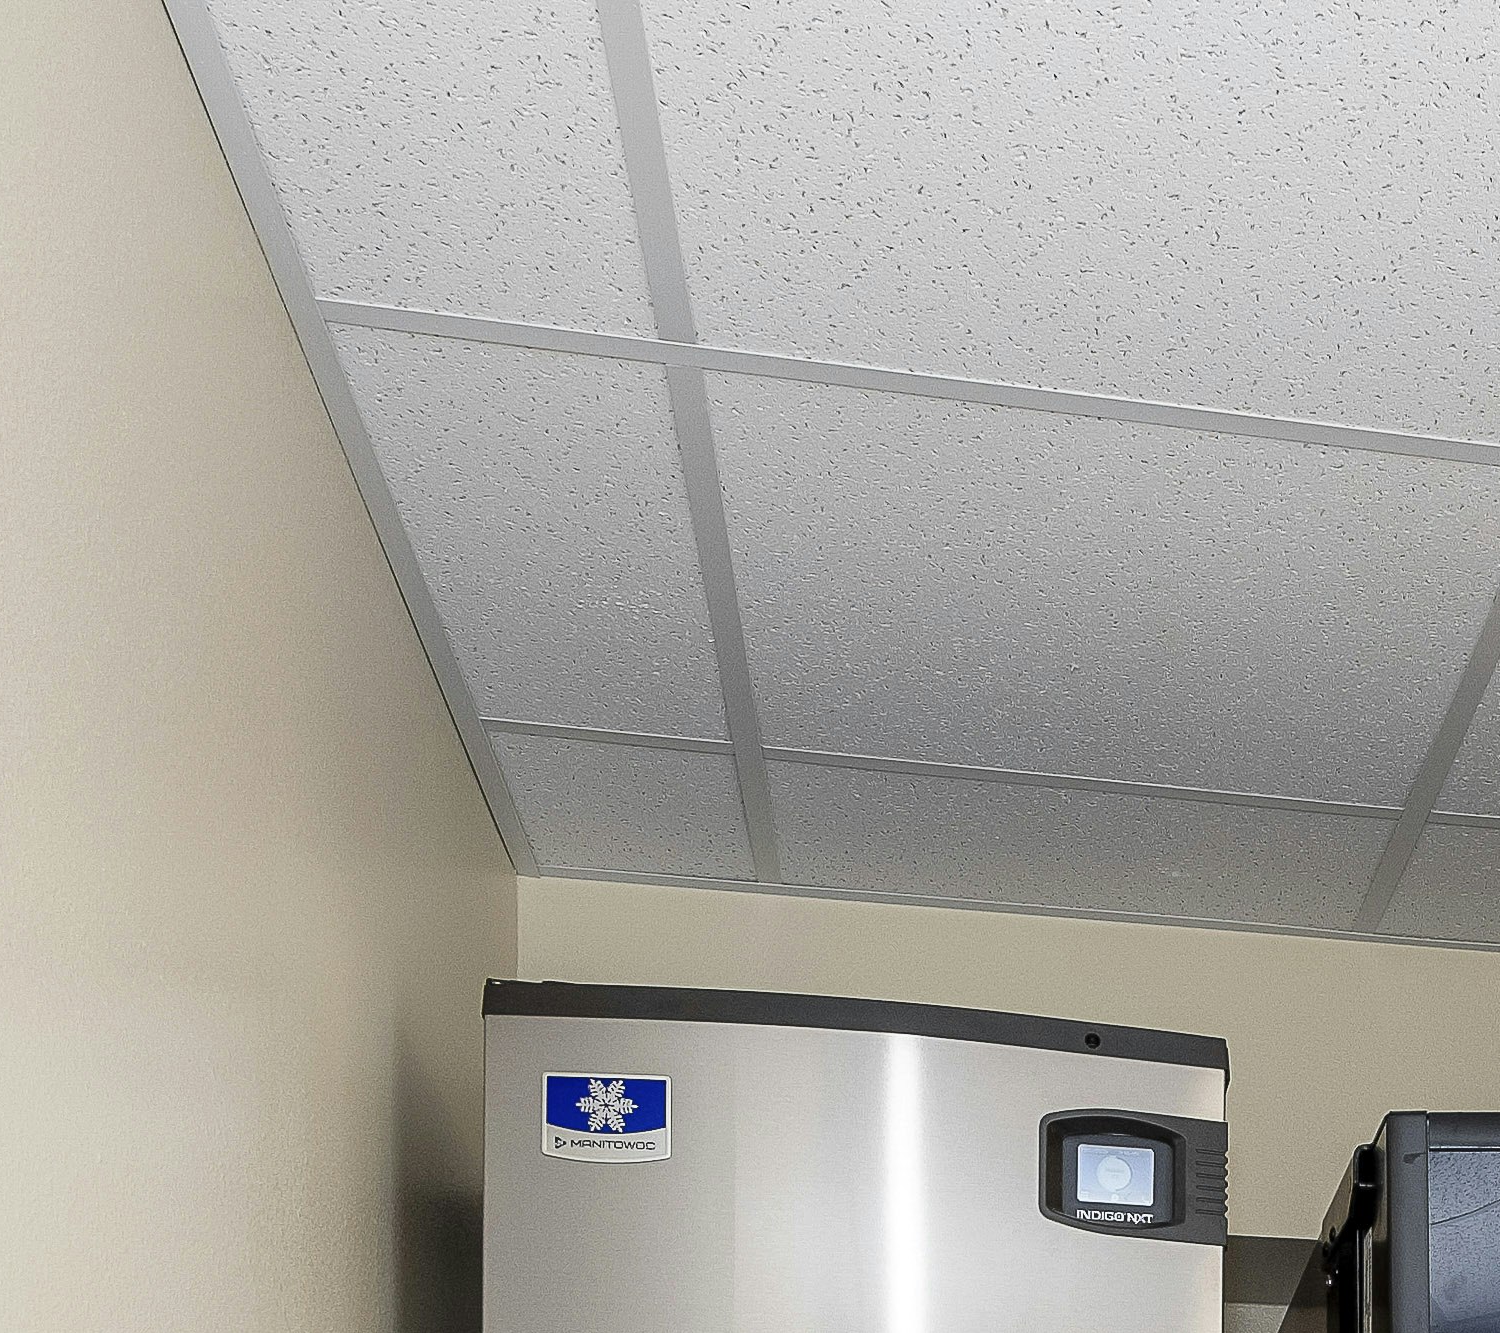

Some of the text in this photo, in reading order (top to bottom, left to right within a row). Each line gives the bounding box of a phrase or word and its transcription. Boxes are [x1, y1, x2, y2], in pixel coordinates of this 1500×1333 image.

[570, 1139, 656, 1151] MANITOWOC
[1076, 1209, 1154, 1225] INDIGO NXT
